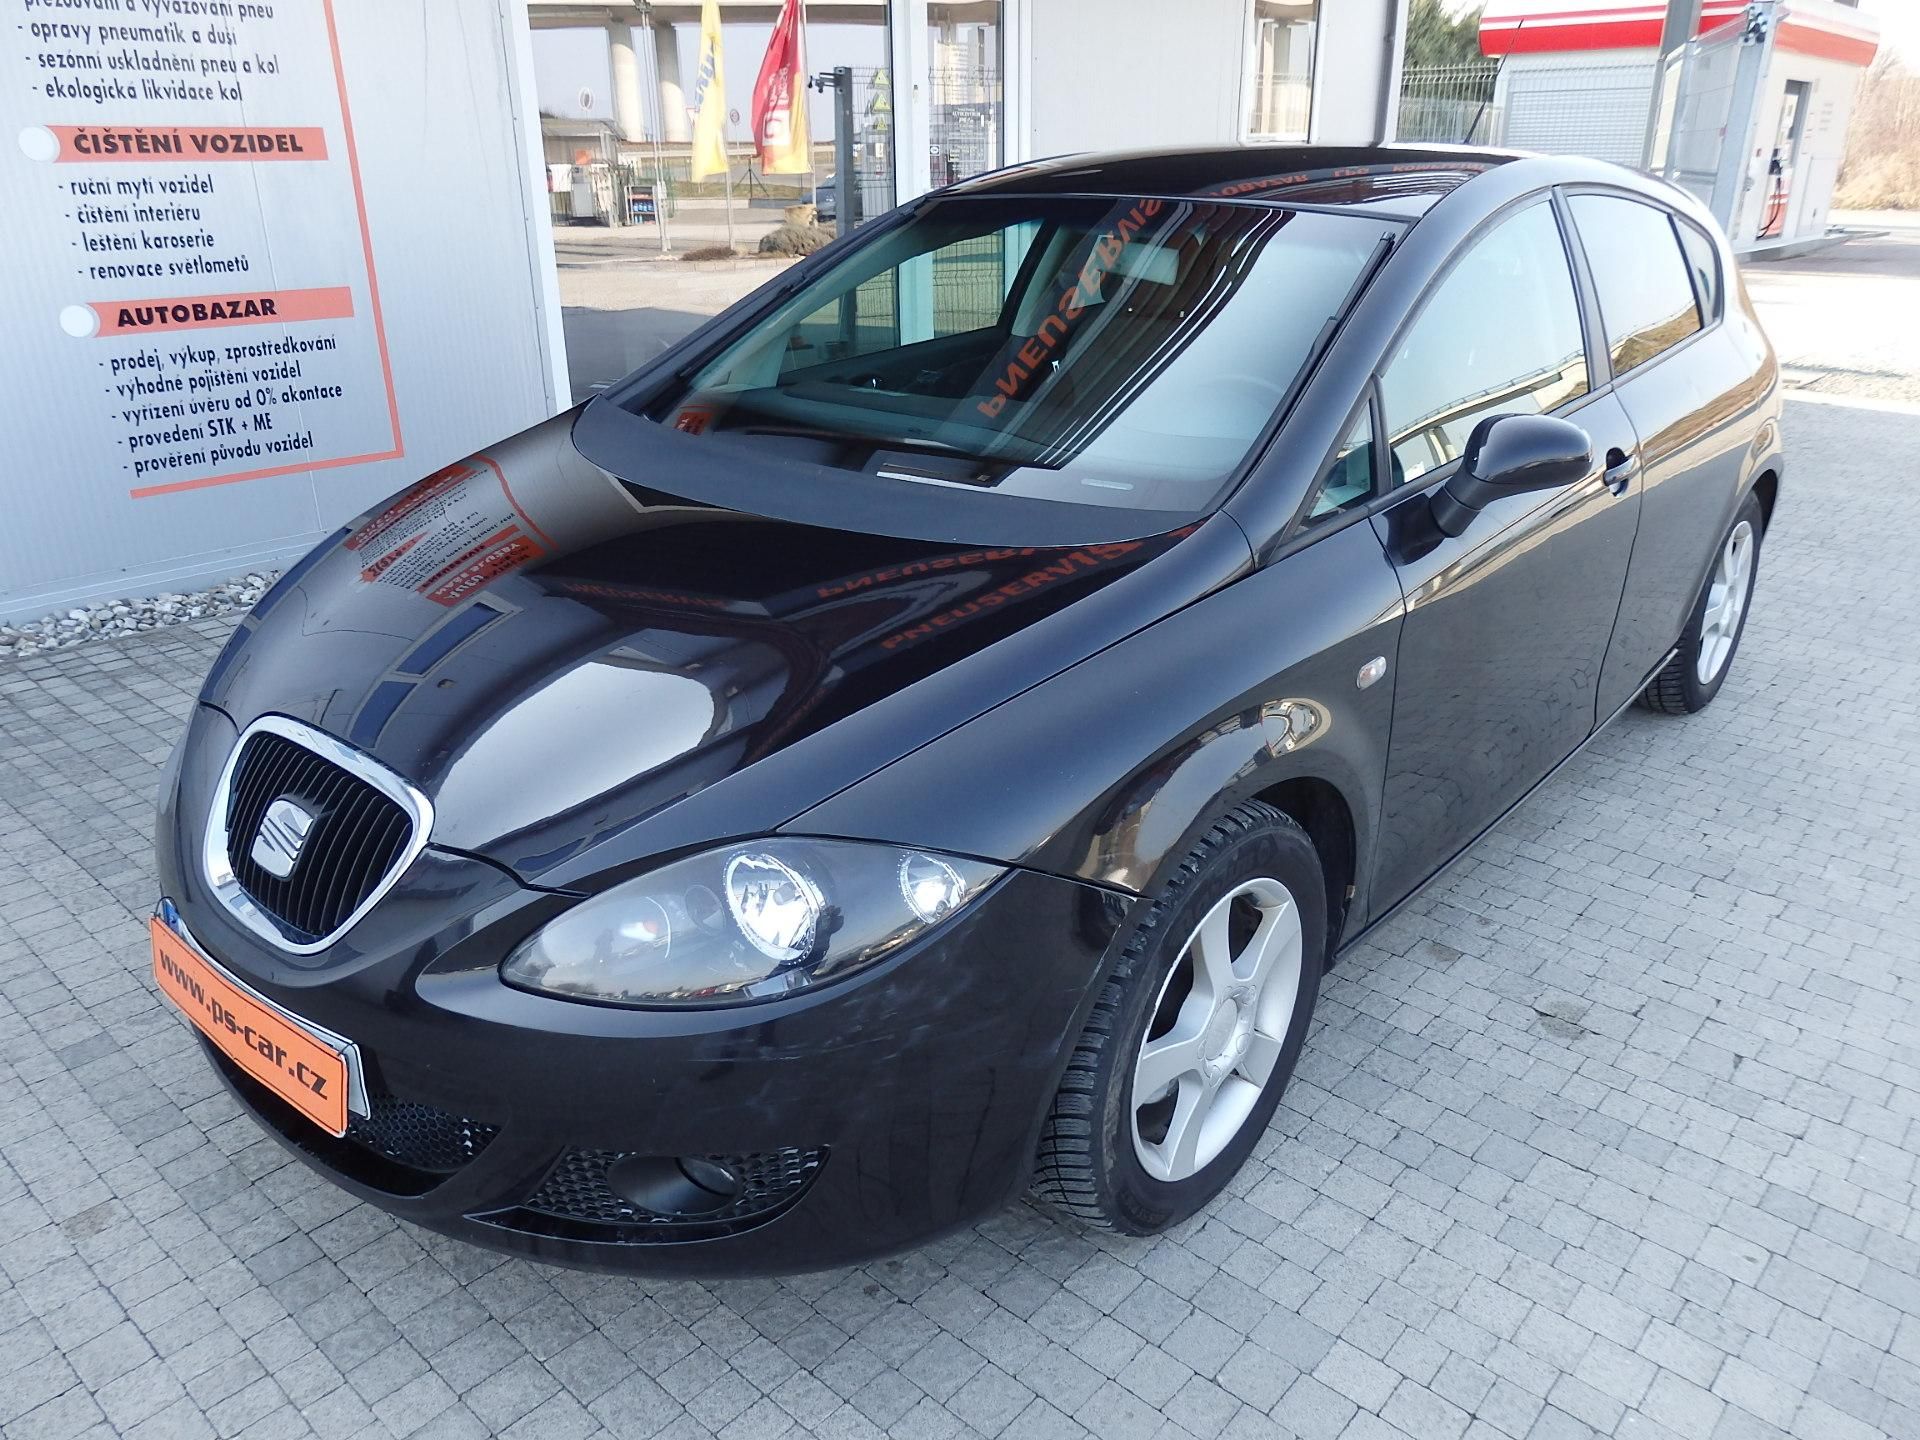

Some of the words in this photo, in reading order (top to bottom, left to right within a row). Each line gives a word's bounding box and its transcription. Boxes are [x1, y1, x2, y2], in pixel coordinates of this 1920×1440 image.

[238, 4, 274, 22] pneu
[31, 22, 91, 44] opravy
[99, 22, 186, 45] pneumatik
[192, 30, 202, 43] a
[207, 23, 237, 45] duší
[38, 49, 102, 69] sezónní
[107, 49, 196, 72] uskladnění
[200, 59, 237, 77] pneu
[243, 60, 252, 74] a
[255, 53, 280, 74] kol
[46, 76, 137, 104] ekologická
[141, 78, 214, 100] likvidace
[217, 80, 243, 101] kol
[74, 127, 183, 154] ČIŠTĚNÍ
[190, 133, 303, 153] VOZIDEL
[70, 177, 112, 195] ruční
[159, 174, 214, 194] vozidel
[77, 204, 129, 223] čištění
[133, 202, 200, 222] interiéru
[82, 232, 138, 252] leštění
[140, 229, 215, 250] karoserie
[90, 263, 163, 280] renovace
[169, 254, 250, 276] světlometů
[117, 298, 278, 328] AUTOBAZAR
[111, 348, 165, 376] prodej,
[169, 345, 220, 369] výkup,
[225, 334, 337, 362] zprostředkování
[117, 374, 184, 402] výhodné
[189, 369, 249, 393] pojištění
[252, 360, 302, 382] vozidel
[122, 401, 185, 427] vyřízení
[190, 395, 231, 415] úvěru
[235, 389, 251, 409] od
[256, 387, 278, 406] 0%
[281, 384, 343, 404] akontace
[128, 422, 204, 453] provedení
[208, 418, 237, 438] STK
[253, 412, 273, 432] ME
[134, 450, 207, 479] prověření
[210, 440, 262, 467] původu
[266, 431, 314, 454] vozidel
[160, 949, 328, 1100] www.ps-car.cz
